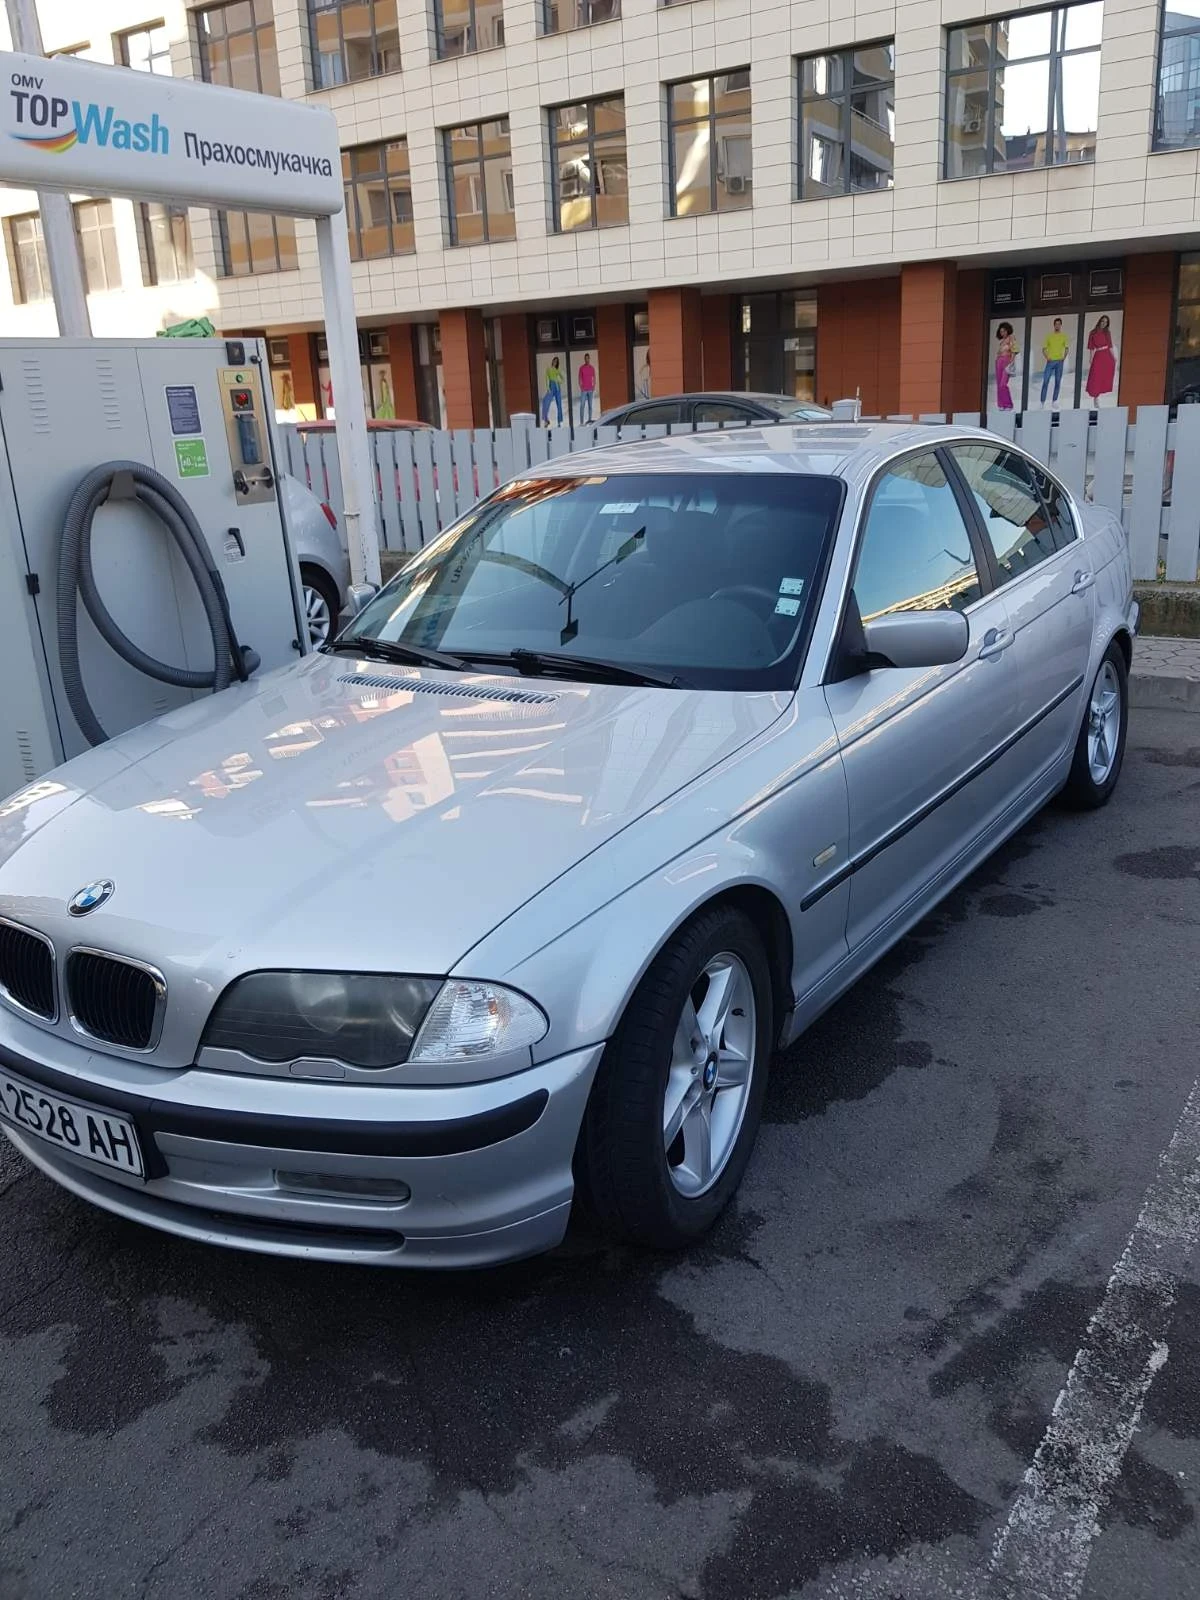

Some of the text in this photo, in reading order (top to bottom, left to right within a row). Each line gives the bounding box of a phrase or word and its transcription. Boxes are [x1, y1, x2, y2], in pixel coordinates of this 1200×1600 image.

[11, 73, 44, 90] OMV
[184, 131, 333, 178] Прахосмукачка
[6, 1082, 81, 1147] 2528
[86, 1115, 134, 1167] AH
